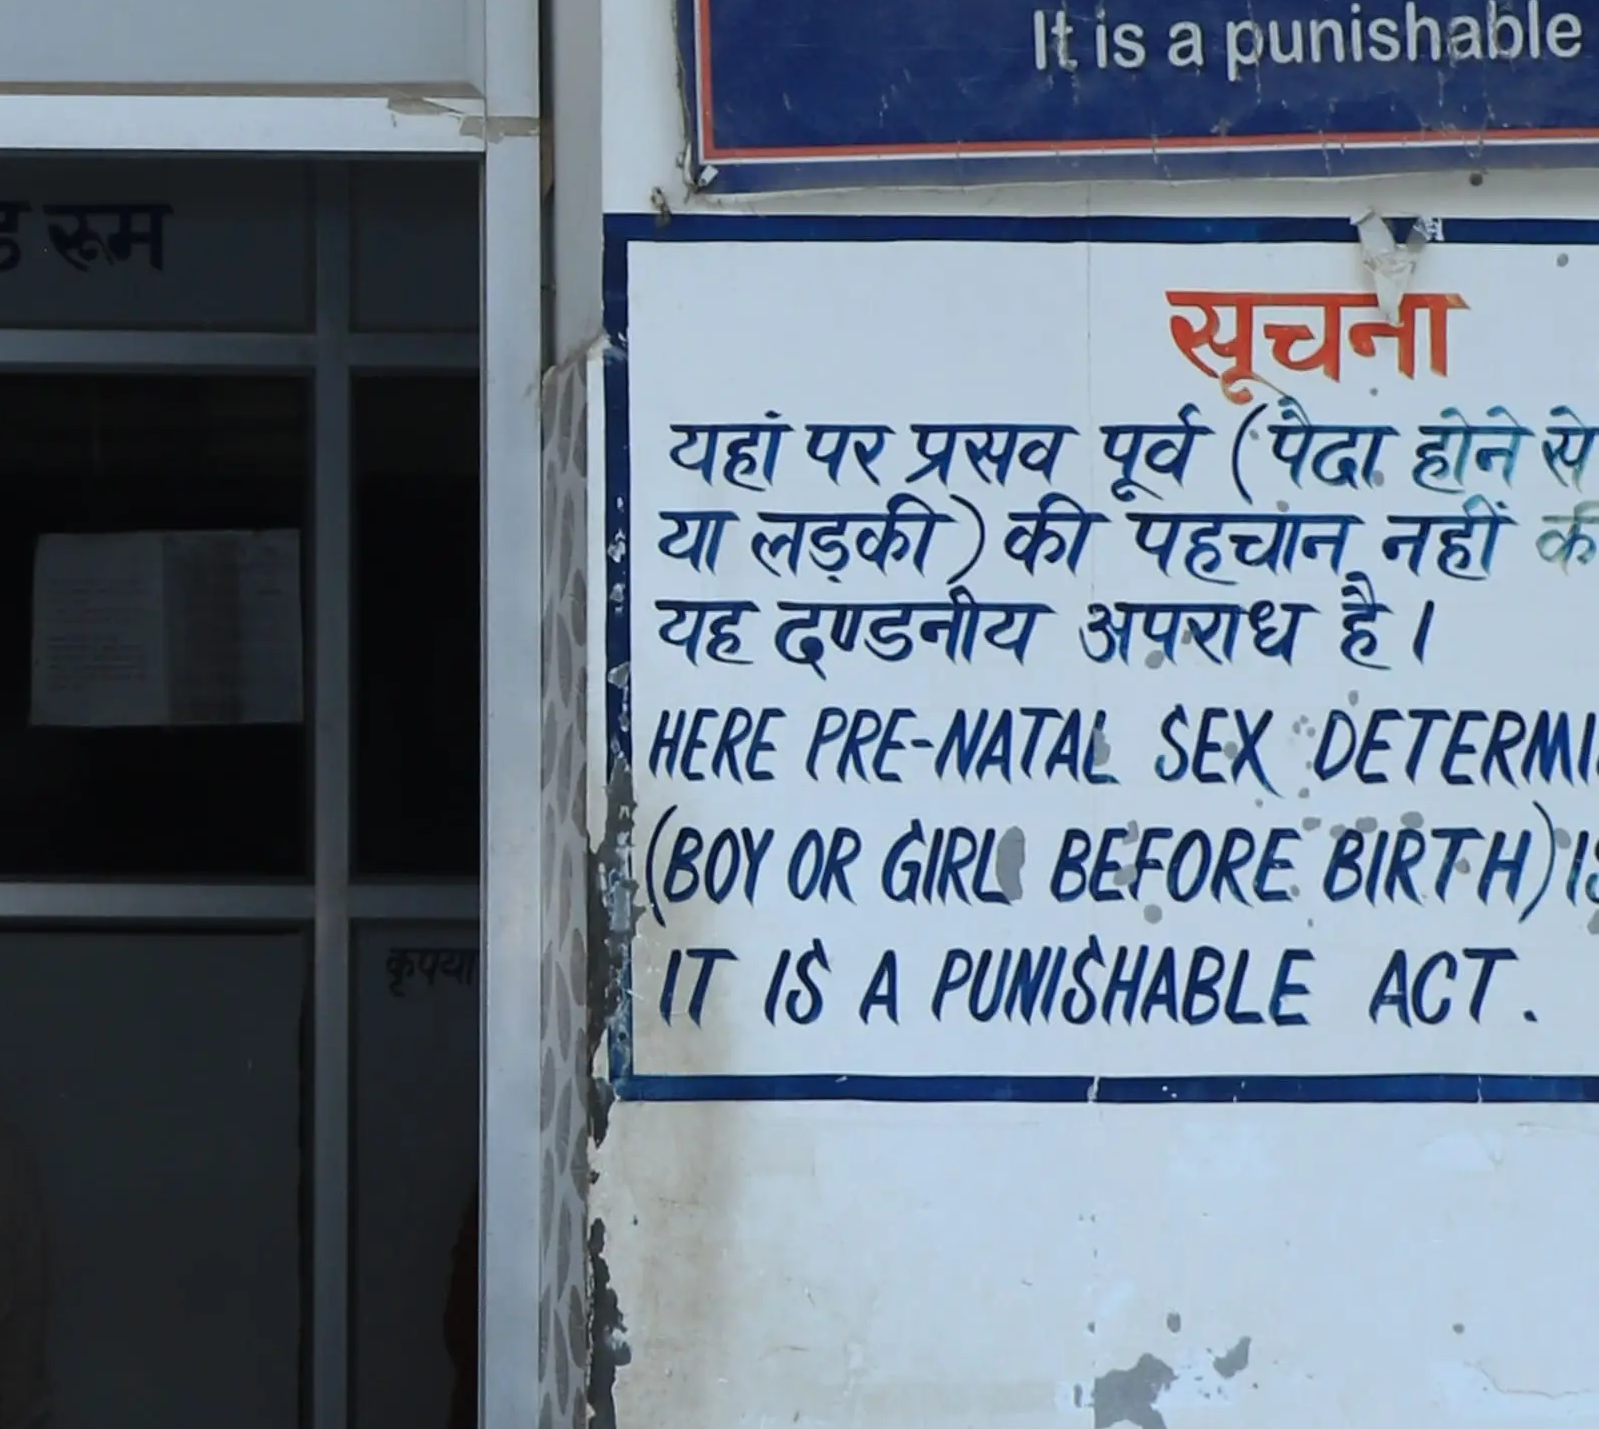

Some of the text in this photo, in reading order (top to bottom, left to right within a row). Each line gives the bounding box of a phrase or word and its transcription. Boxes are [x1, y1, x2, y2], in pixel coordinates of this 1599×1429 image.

[1032, 0, 1583, 82] It is a punishable
[43, 202, 174, 272] रूम
[1166, 290, 1470, 404] सूचना
[669, 396, 1599, 507] यहां पर प्रसव पूर्व (पैदा होने से
[658, 510, 737, 575] या
[754, 492, 985, 587] लड़की)
[1004, 491, 1110, 575] की
[1128, 511, 1366, 586] पहचान
[1382, 493, 1519, 581] नहीं
[656, 599, 763, 672] यह
[775, 583, 1059, 682] दण्डनीय
[1081, 597, 1322, 672] अपराध
[649, 705, 1599, 796] HERE PRE-NATAL SEX DETERMI
[646, 804, 774, 927] (BOY
[788, 827, 863, 903] OR
[882, 819, 1011, 905] GIRL
[1050, 825, 1301, 905] BEFORE
[1323, 799, 1557, 924] BIRTH)
[658, 935, 1539, 1032] IT IS A PUNISHABLE ACT.
